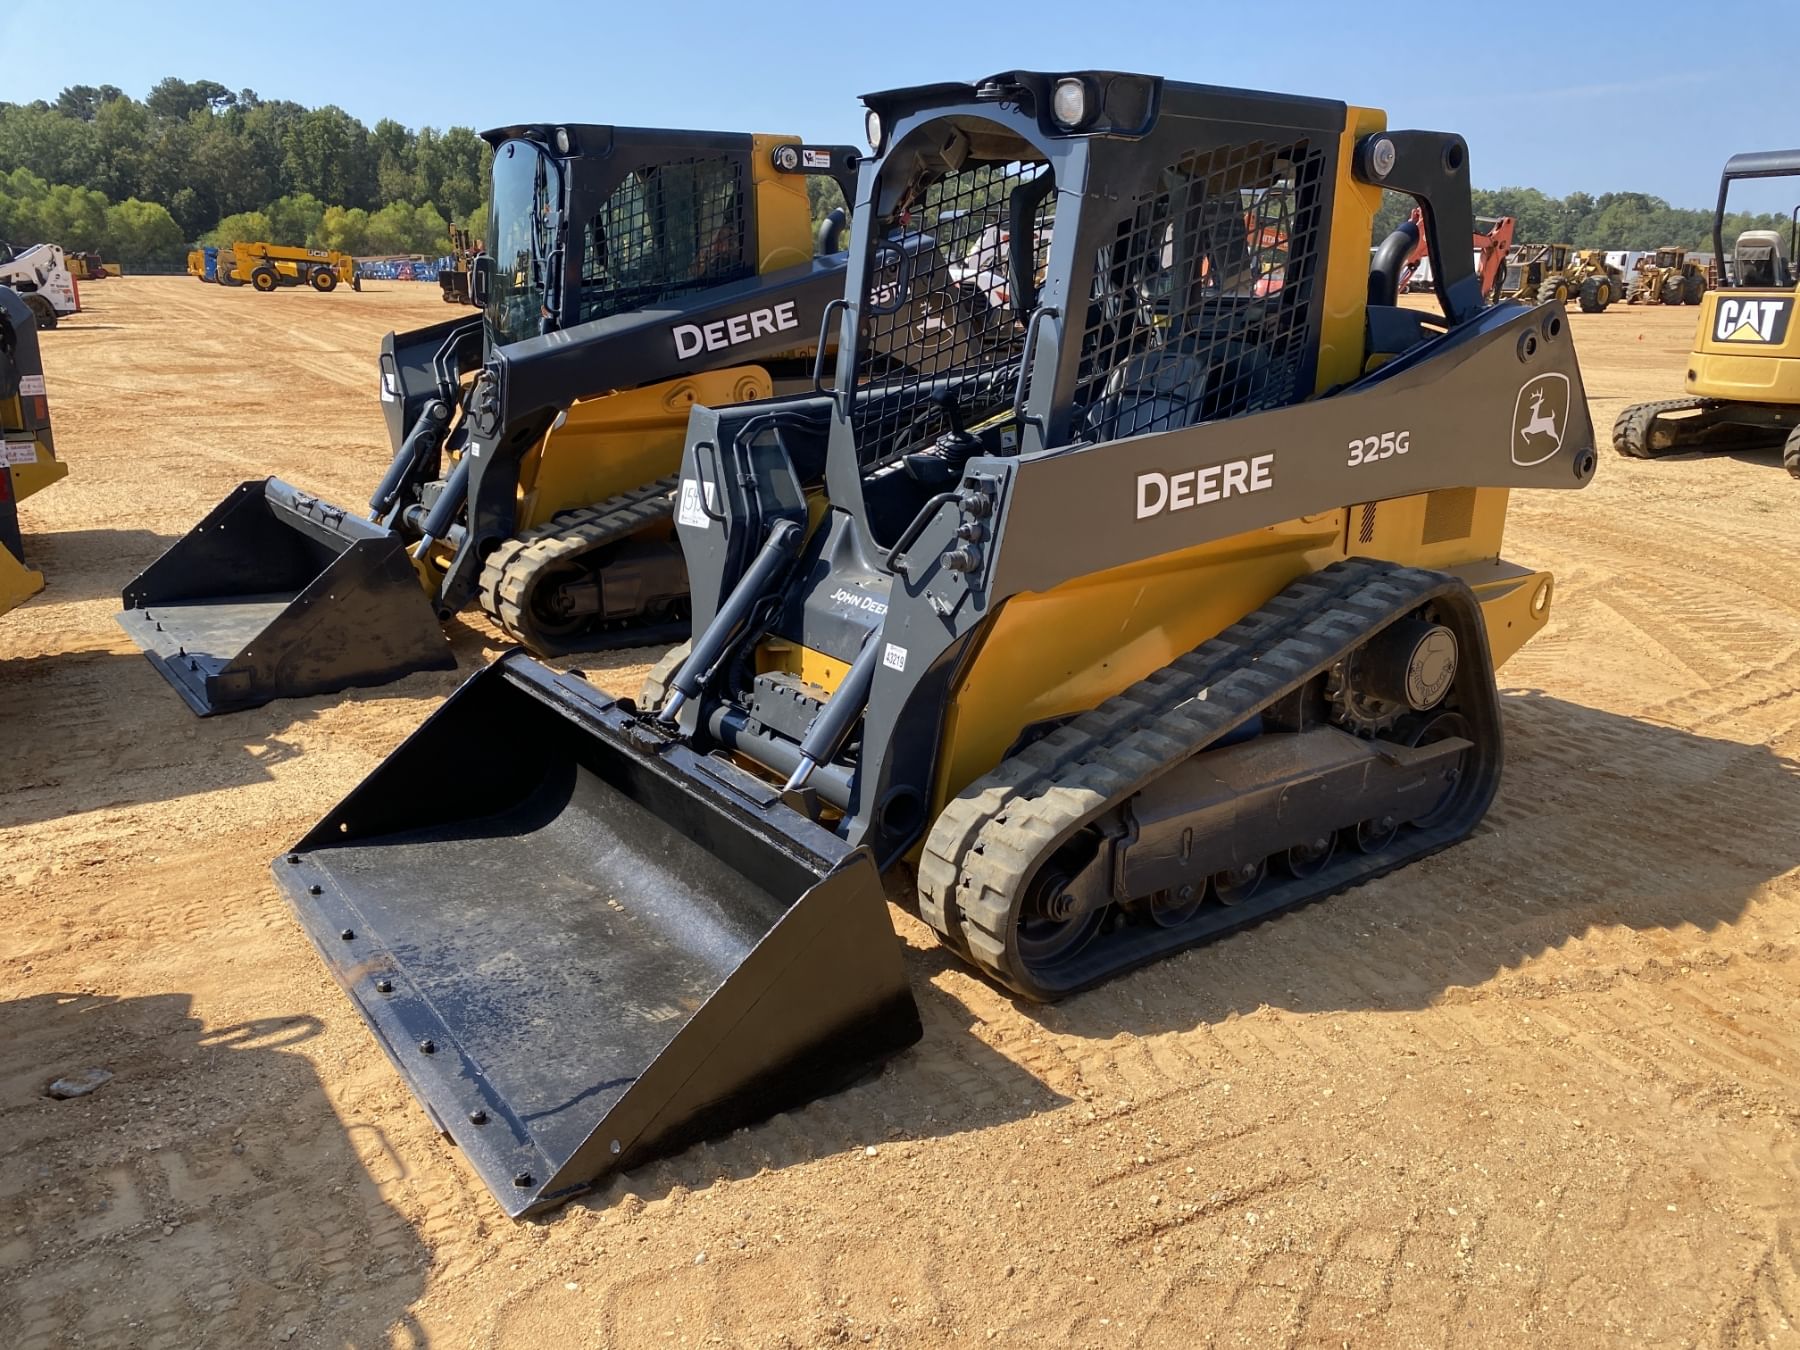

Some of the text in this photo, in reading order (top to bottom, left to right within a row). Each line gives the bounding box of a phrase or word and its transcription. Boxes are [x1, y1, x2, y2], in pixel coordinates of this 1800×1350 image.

[307, 249, 328, 258] JCB
[672, 300, 799, 360] DEERE
[1717, 299, 1784, 341] CAT
[1347, 431, 1410, 467] 325G
[1136, 453, 1274, 519] DEERE
[830, 588, 861, 607] JOHN
